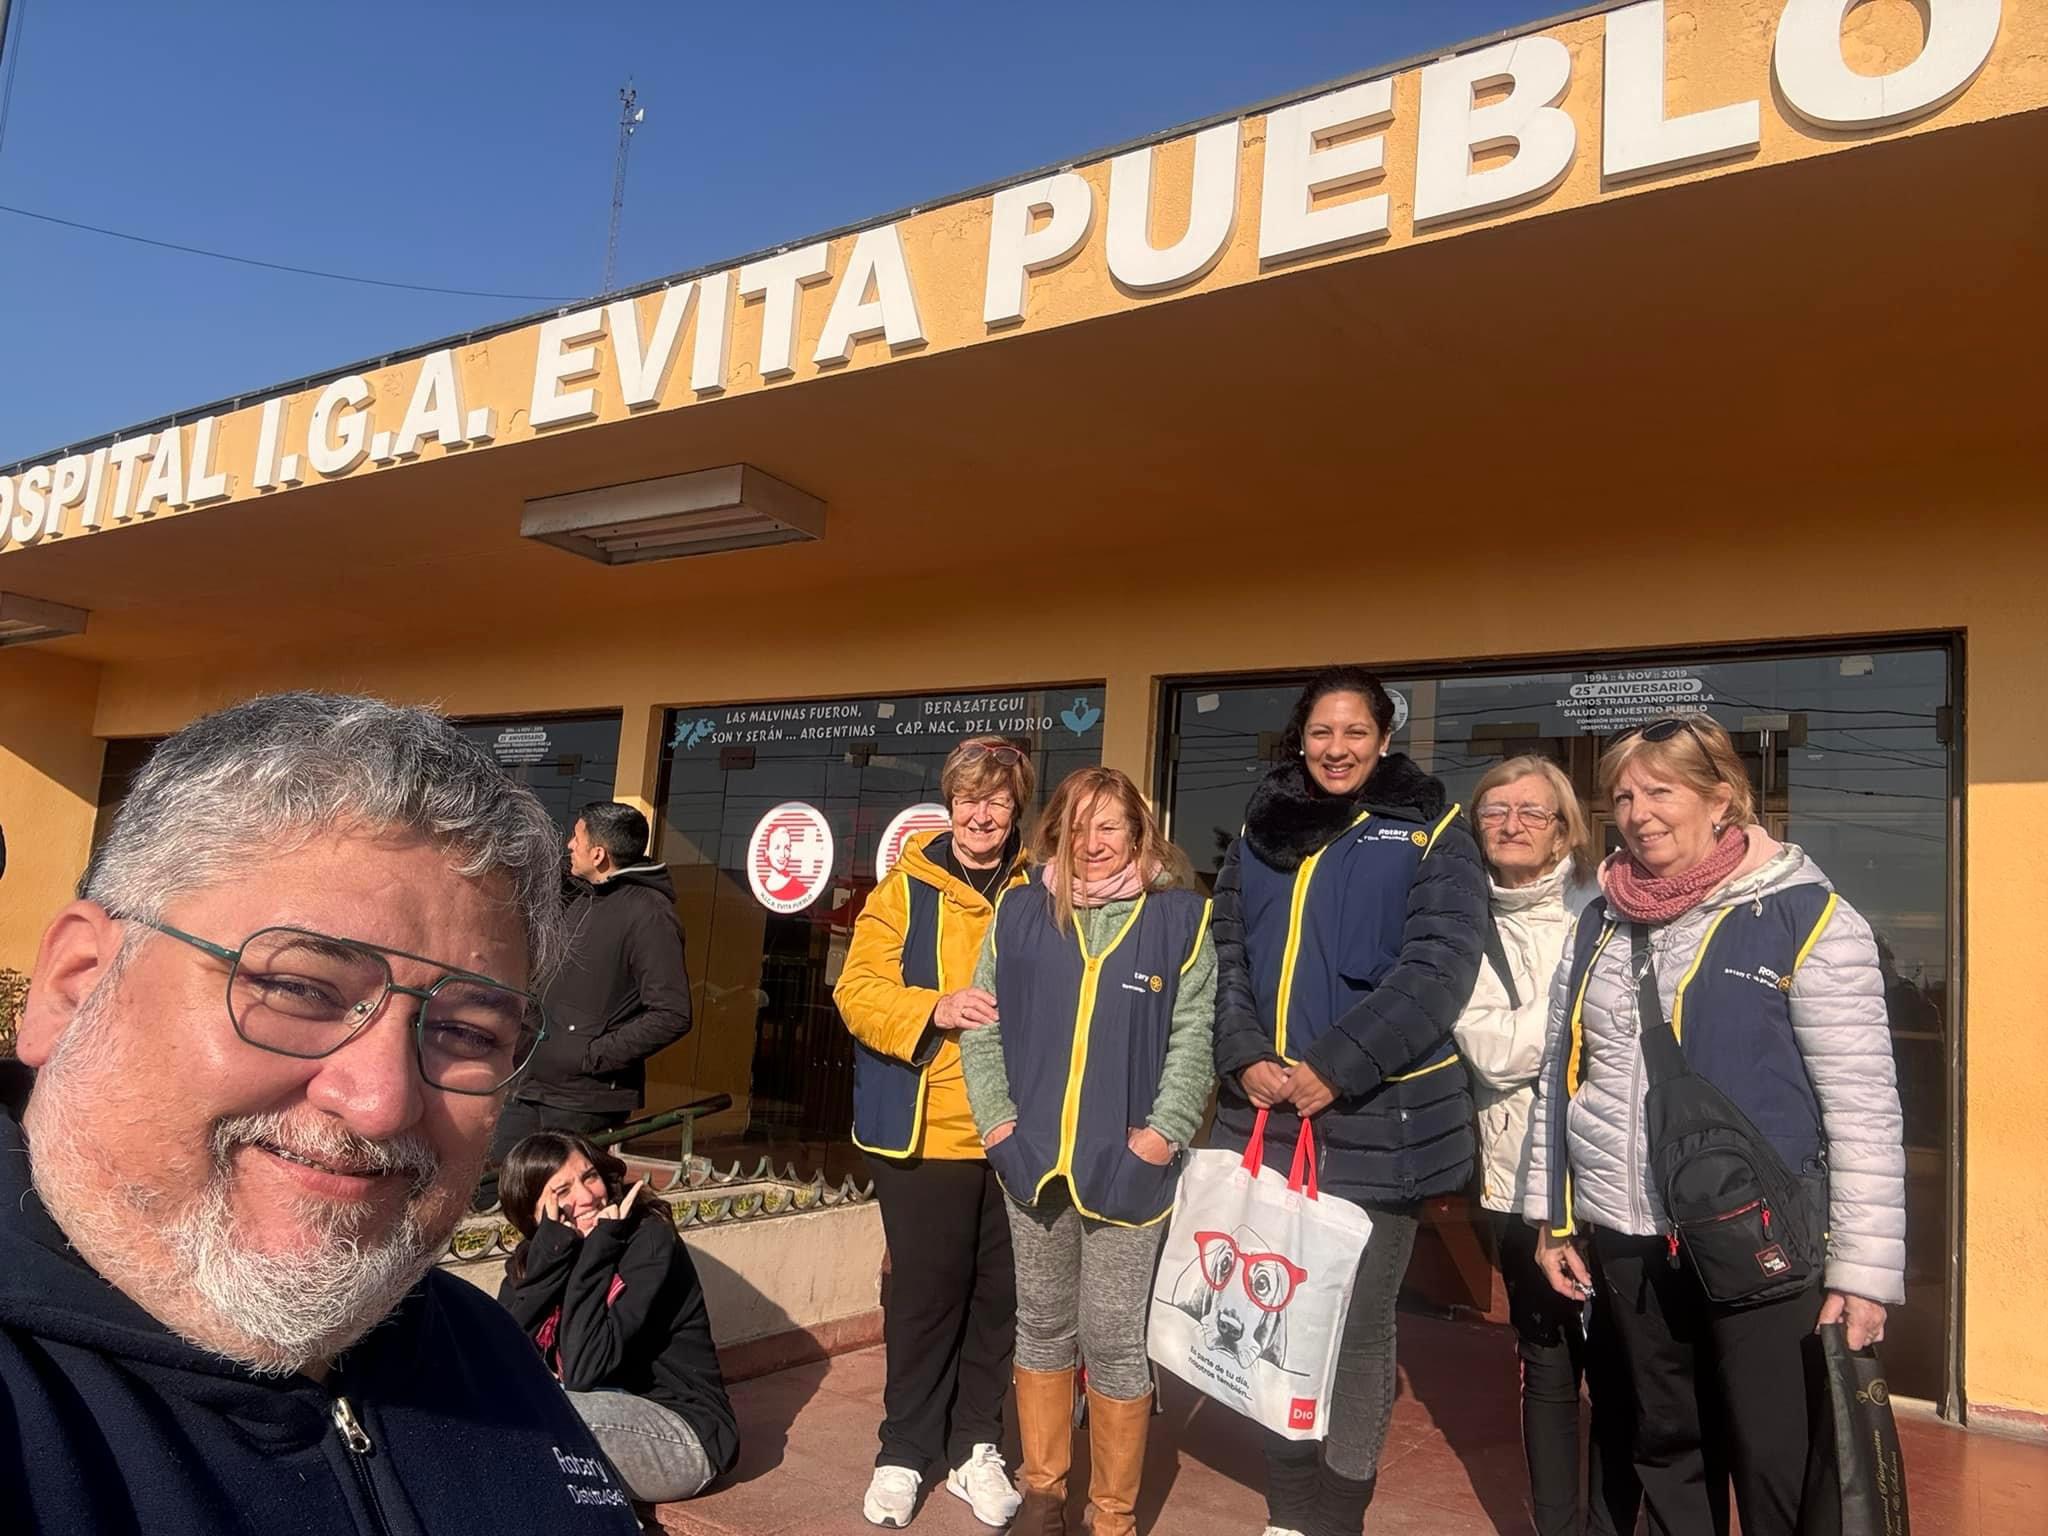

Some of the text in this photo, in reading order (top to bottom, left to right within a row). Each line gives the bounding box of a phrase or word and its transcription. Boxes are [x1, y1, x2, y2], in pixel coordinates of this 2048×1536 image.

[253, 350, 497, 490] I.G.A.
[529, 224, 929, 428] EVITA
[984, 0, 2000, 328] PUEBLO
[1617, 673, 1624, 681] 4
[1627, 671, 1652, 680] NOV
[1662, 670, 1687, 679] 2019
[1598, 682, 1693, 695] ANIVERSARIO
[924, 697, 1025, 715] BERAZATEGUI
[1556, 693, 1714, 707] SIGAMOS TRABAJANDO POR LA
[726, 712, 746, 725] LAS
[749, 708, 806, 723] MALVINAS
[1563, 704, 1708, 717] SALUD DE NUESTRO PUEBLO
[895, 716, 1053, 735] CAP. NAC. DEL VIDRIO
[711, 731, 732, 744] SON
[736, 731, 743, 743] Y
[746, 725, 782, 743] SERÁN
[800, 725, 876, 740] ARGENTINAS
[552, 1446, 609, 1483] Rotary
